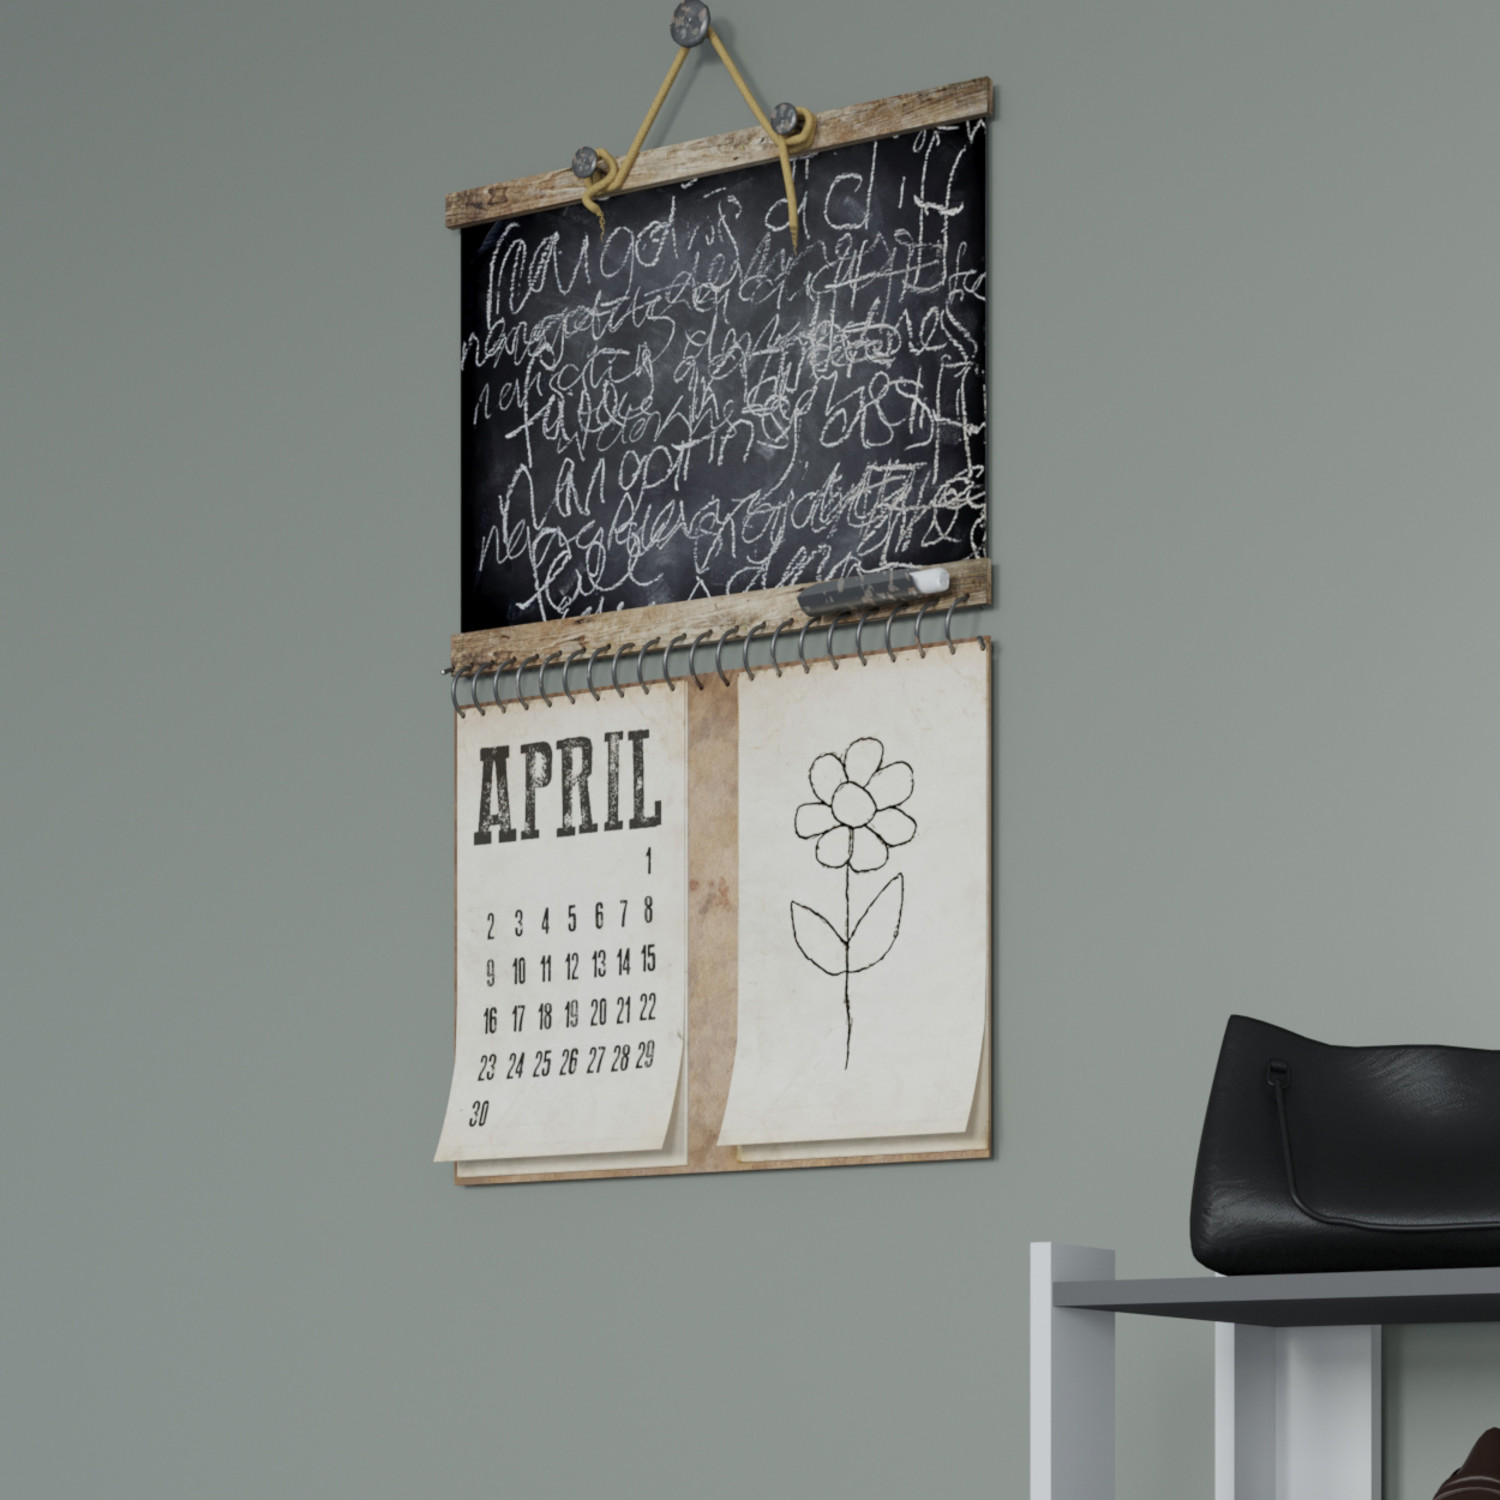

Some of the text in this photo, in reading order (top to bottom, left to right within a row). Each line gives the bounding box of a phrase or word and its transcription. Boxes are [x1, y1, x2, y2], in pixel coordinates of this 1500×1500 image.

[473, 728, 662, 846] APRIL
[644, 846, 653, 876] 1
[486, 896, 654, 941] 2 3 4 5 6 7 8
[485, 944, 657, 988] 9 10 11 12 13 14 15
[483, 992, 657, 1035] 16 17 18 19 20 21 22
[476, 1039, 656, 1083] 23 24 25 26 27 28 29
[468, 1100, 490, 1128] 30
